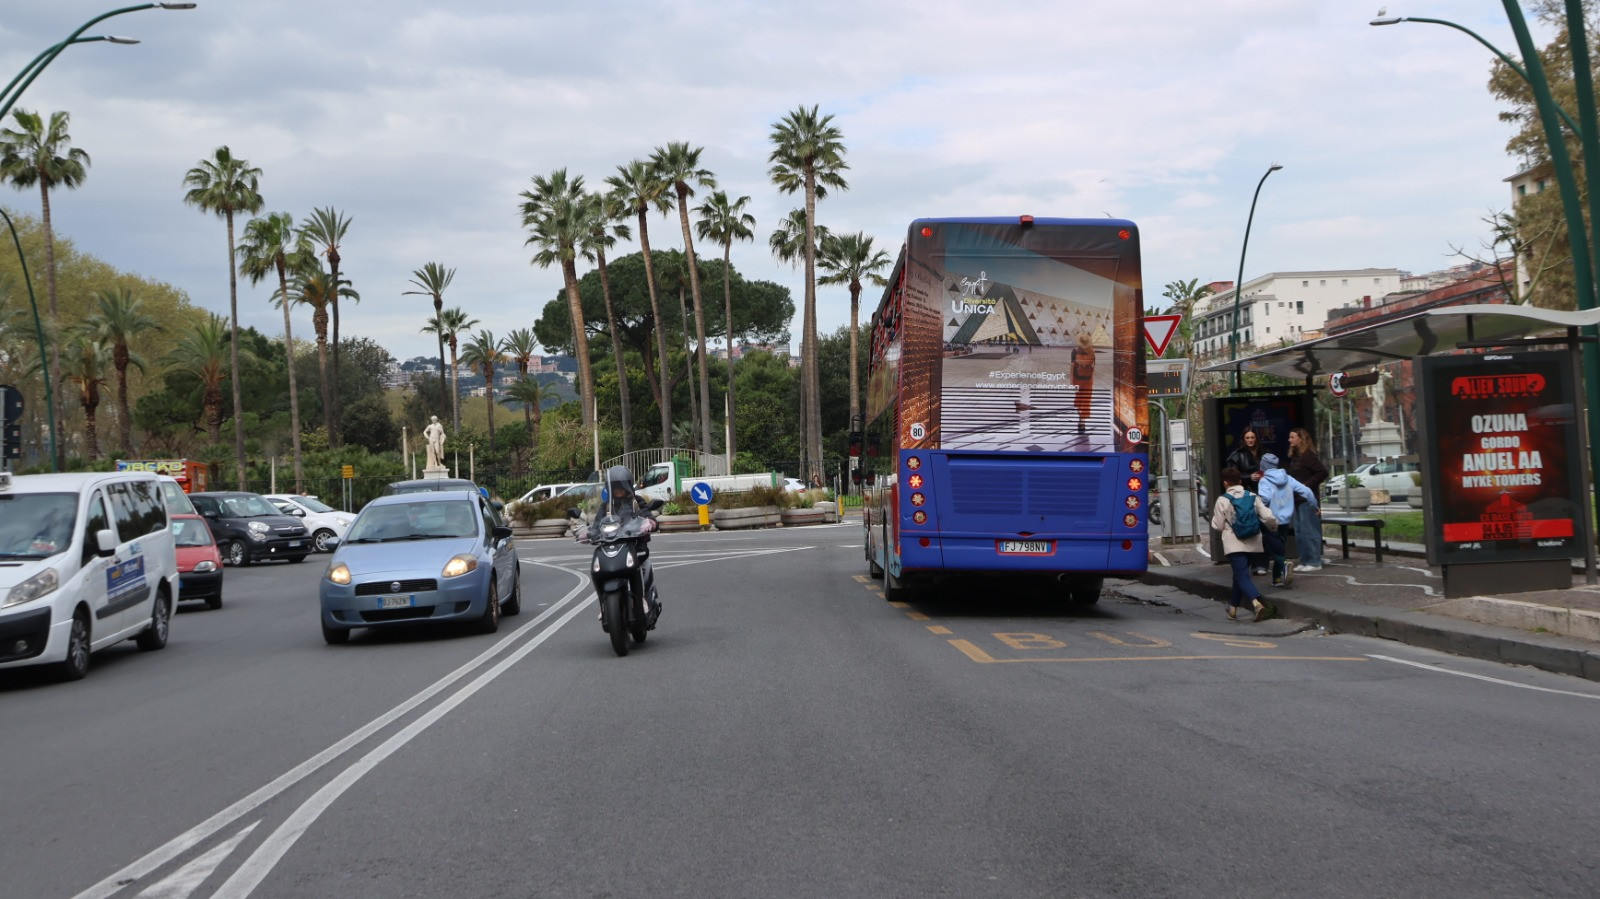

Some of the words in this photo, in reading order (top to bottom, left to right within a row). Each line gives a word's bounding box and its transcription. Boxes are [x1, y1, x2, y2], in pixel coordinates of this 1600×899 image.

[1471, 413, 1528, 433] OZUNA
[913, 427, 923, 437] 80
[1128, 431, 1140, 440] 100
[1481, 436, 1520, 449] GORDO
[1463, 452, 1516, 471] ANUEL
[1518, 451, 1543, 469] AA
[1462, 476, 1493, 488] MYKE
[1494, 473, 1542, 486] TOWERS
[991, 632, 1278, 649] BUS
